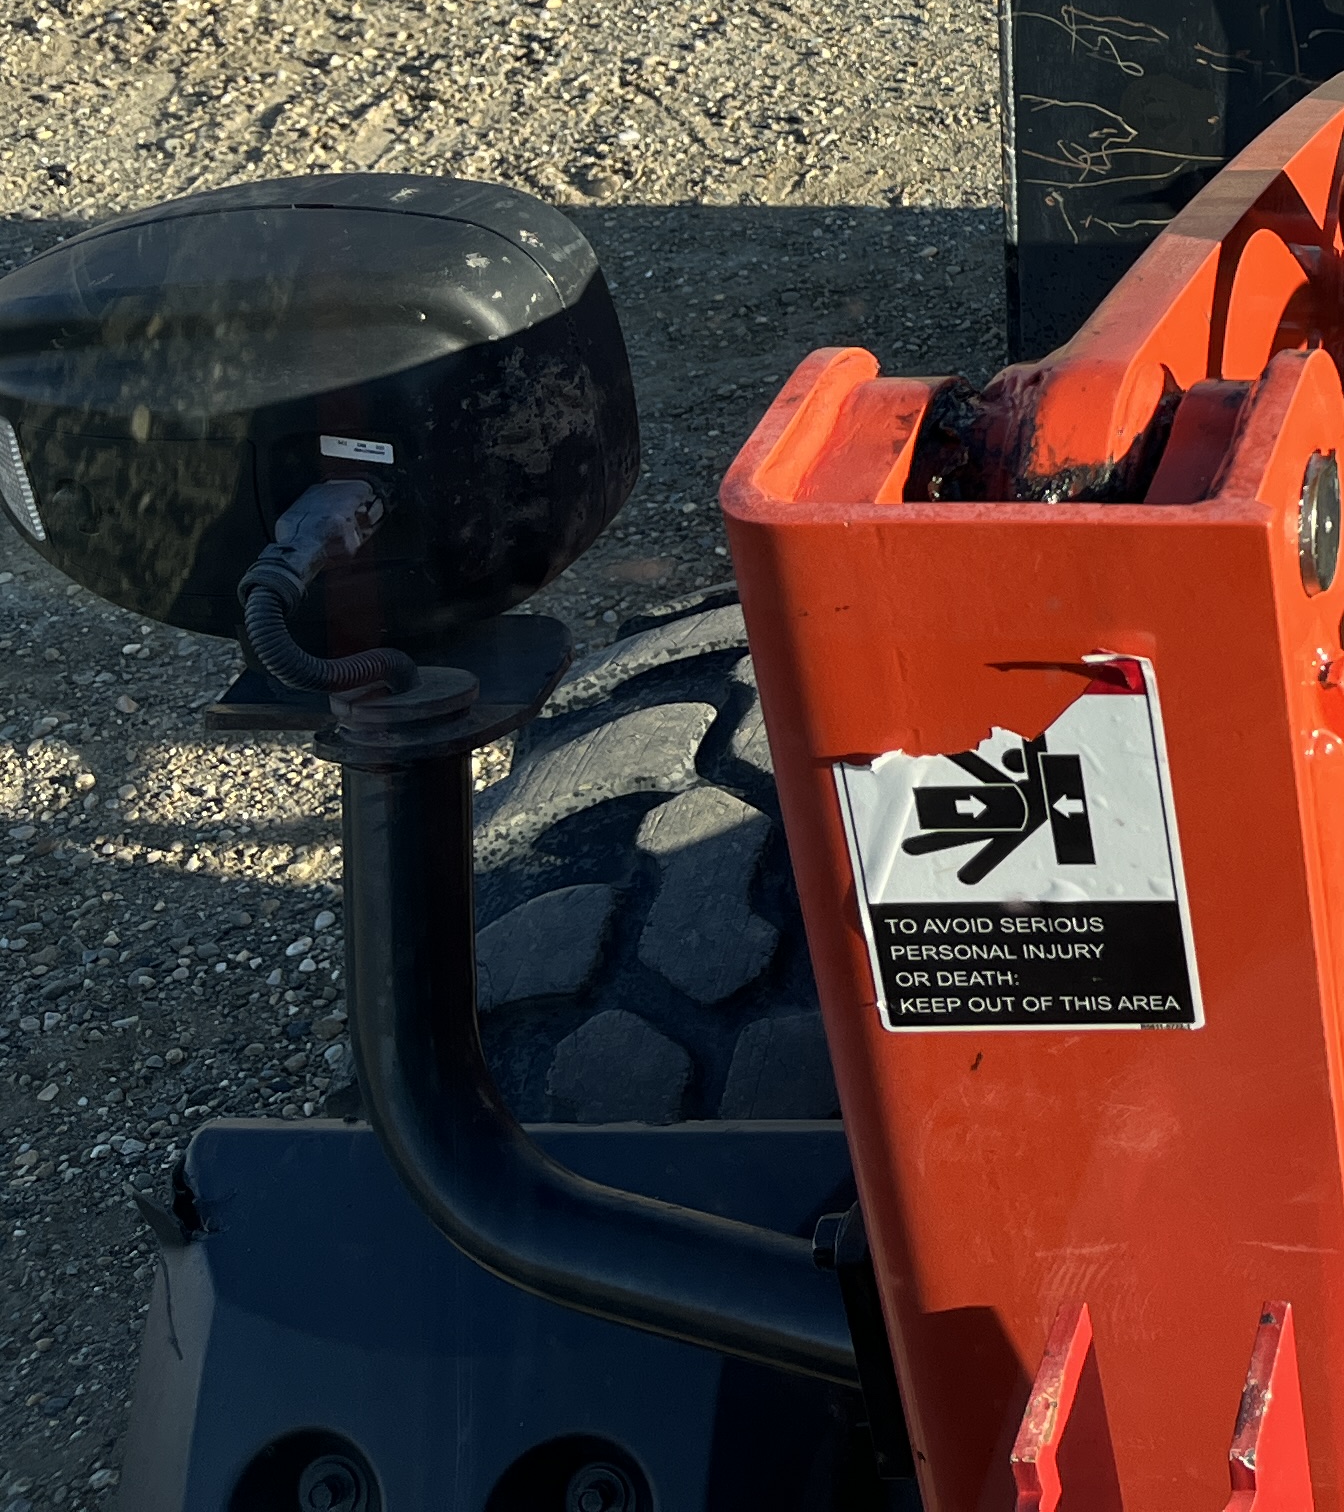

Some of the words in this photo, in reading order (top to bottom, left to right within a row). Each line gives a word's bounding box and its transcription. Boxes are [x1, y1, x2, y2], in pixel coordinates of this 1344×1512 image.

[885, 919, 917, 933] TO
[924, 918, 992, 933] AVOID
[1000, 917, 1103, 932] SERIOUS
[891, 945, 1017, 960] PERSONAL
[1023, 944, 1103, 959] INJURY
[896, 972, 930, 986] OR
[937, 971, 1018, 986] DEATH:
[901, 998, 960, 1013] KEEP
[968, 997, 1015, 1012] OUT
[1023, 997, 1052, 1011] OF
[1060, 996, 1112, 1010] THIS
[1118, 996, 1180, 1010] AREA
